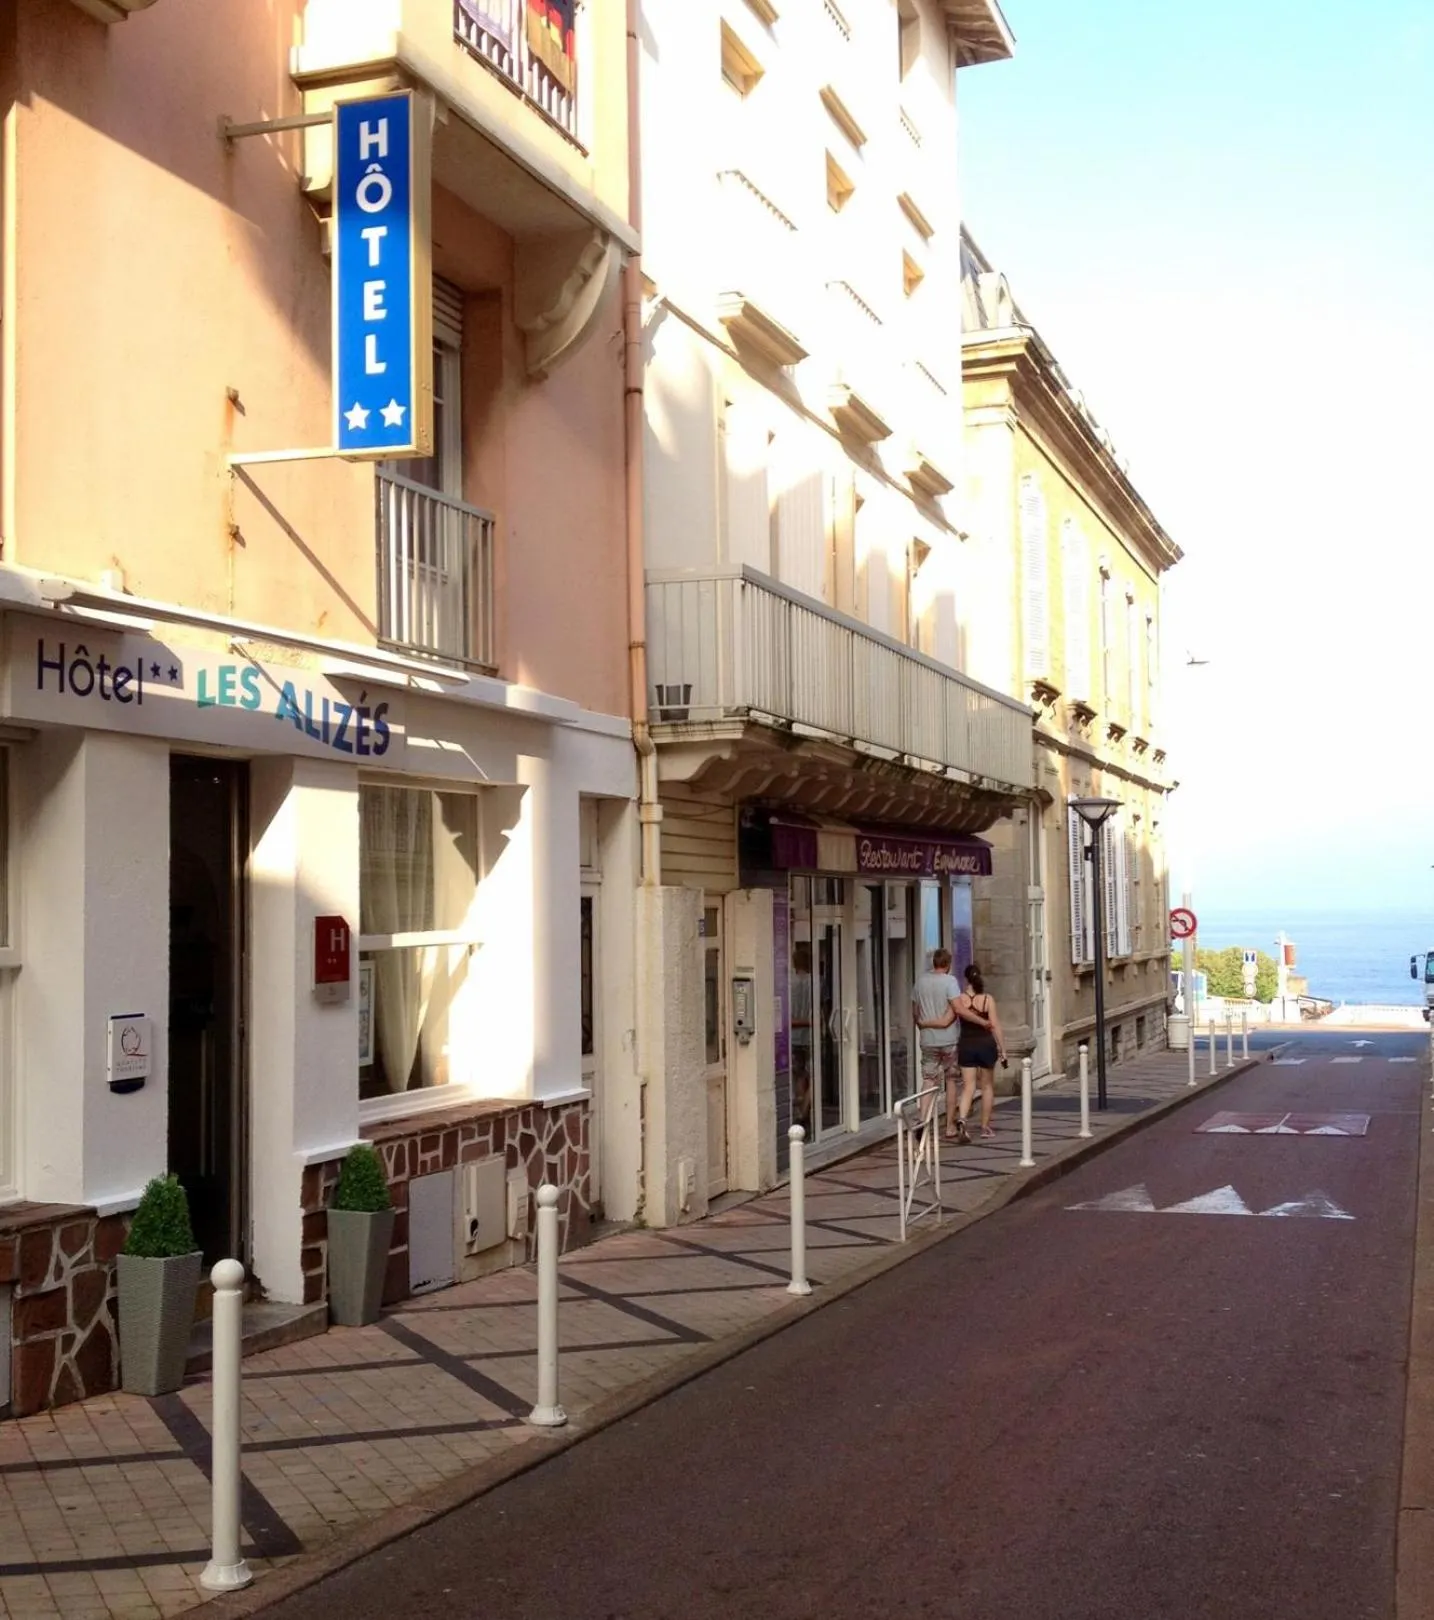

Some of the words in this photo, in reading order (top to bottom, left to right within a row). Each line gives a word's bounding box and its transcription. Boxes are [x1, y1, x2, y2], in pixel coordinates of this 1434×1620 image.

[356, 118, 392, 375] HÔTEL
[37, 638, 144, 705] Hôtel
[196, 665, 260, 712] LES
[275, 680, 390, 756] ALIZÉS
[330, 928, 345, 952] H
